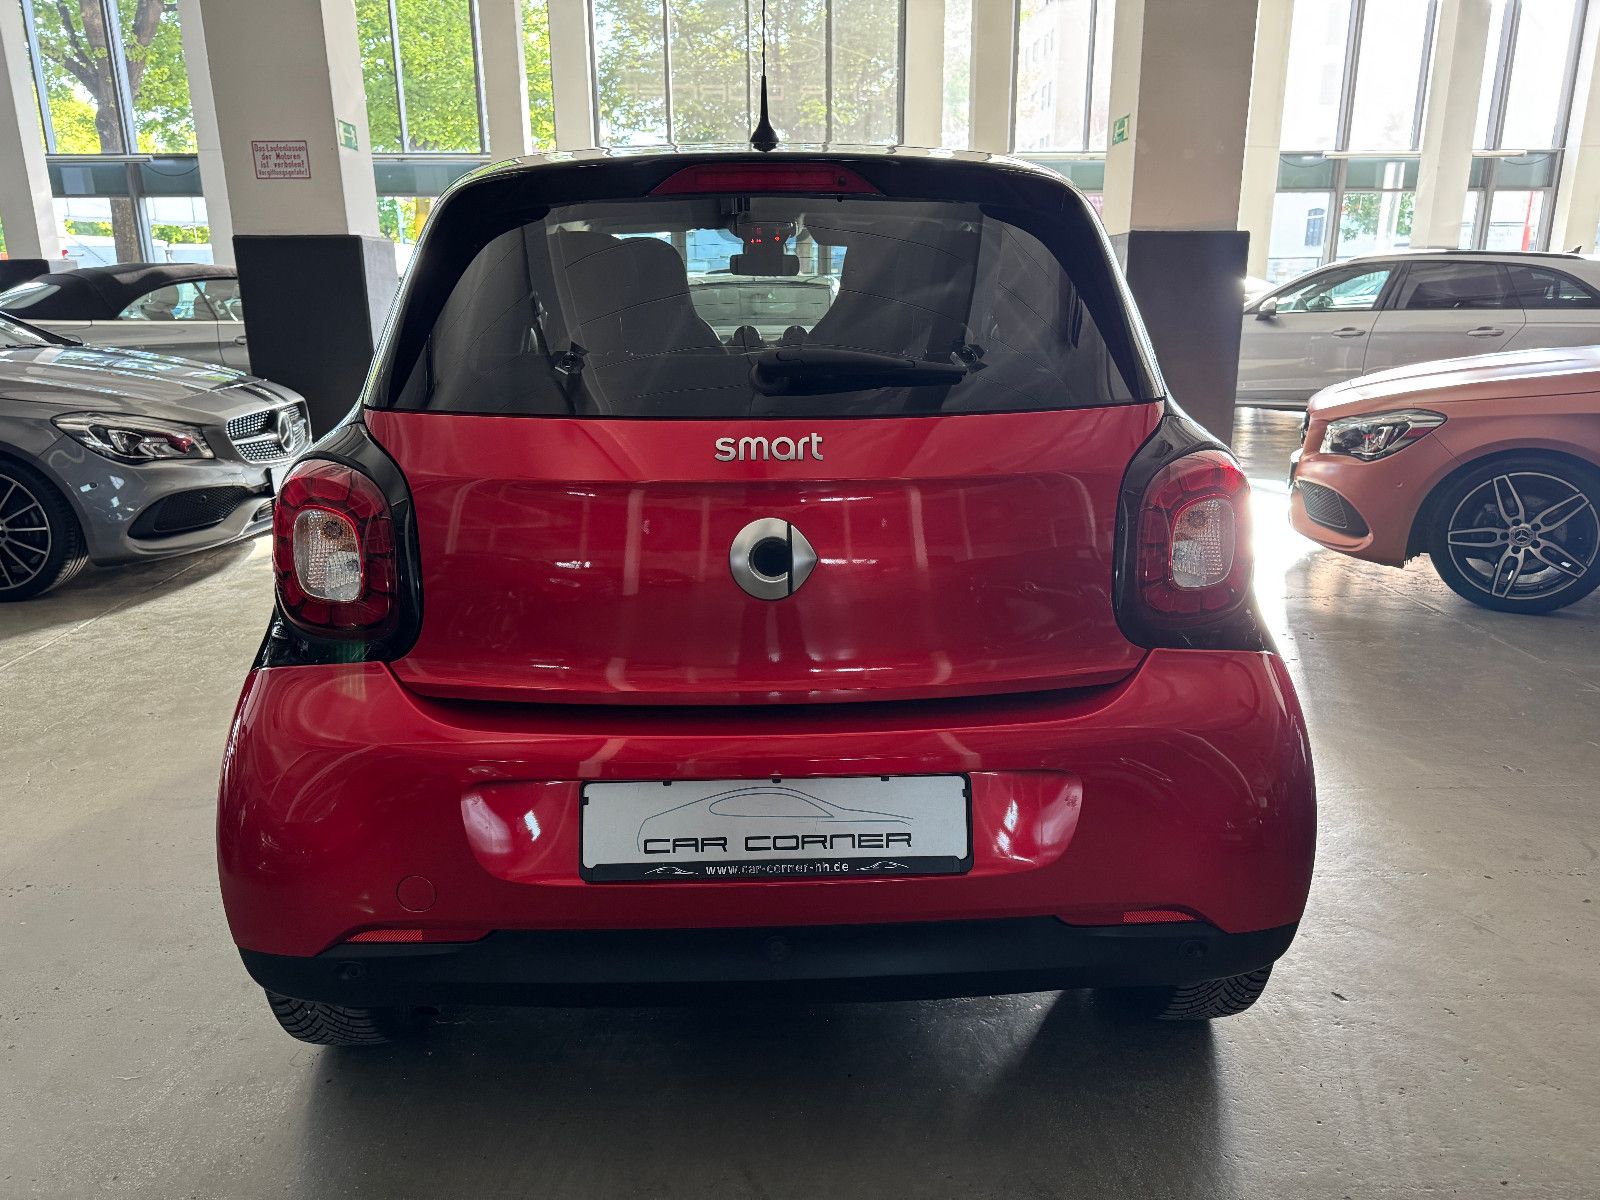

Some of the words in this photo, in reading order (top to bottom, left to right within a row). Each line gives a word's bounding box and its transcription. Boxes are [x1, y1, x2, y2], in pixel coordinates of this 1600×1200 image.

[254, 144, 266, 152] Das
[275, 152, 301, 160] Motoren
[260, 160, 269, 168] ist
[714, 432, 824, 462] smart
[643, 836, 728, 854] CAR
[744, 832, 912, 851] CORNER
